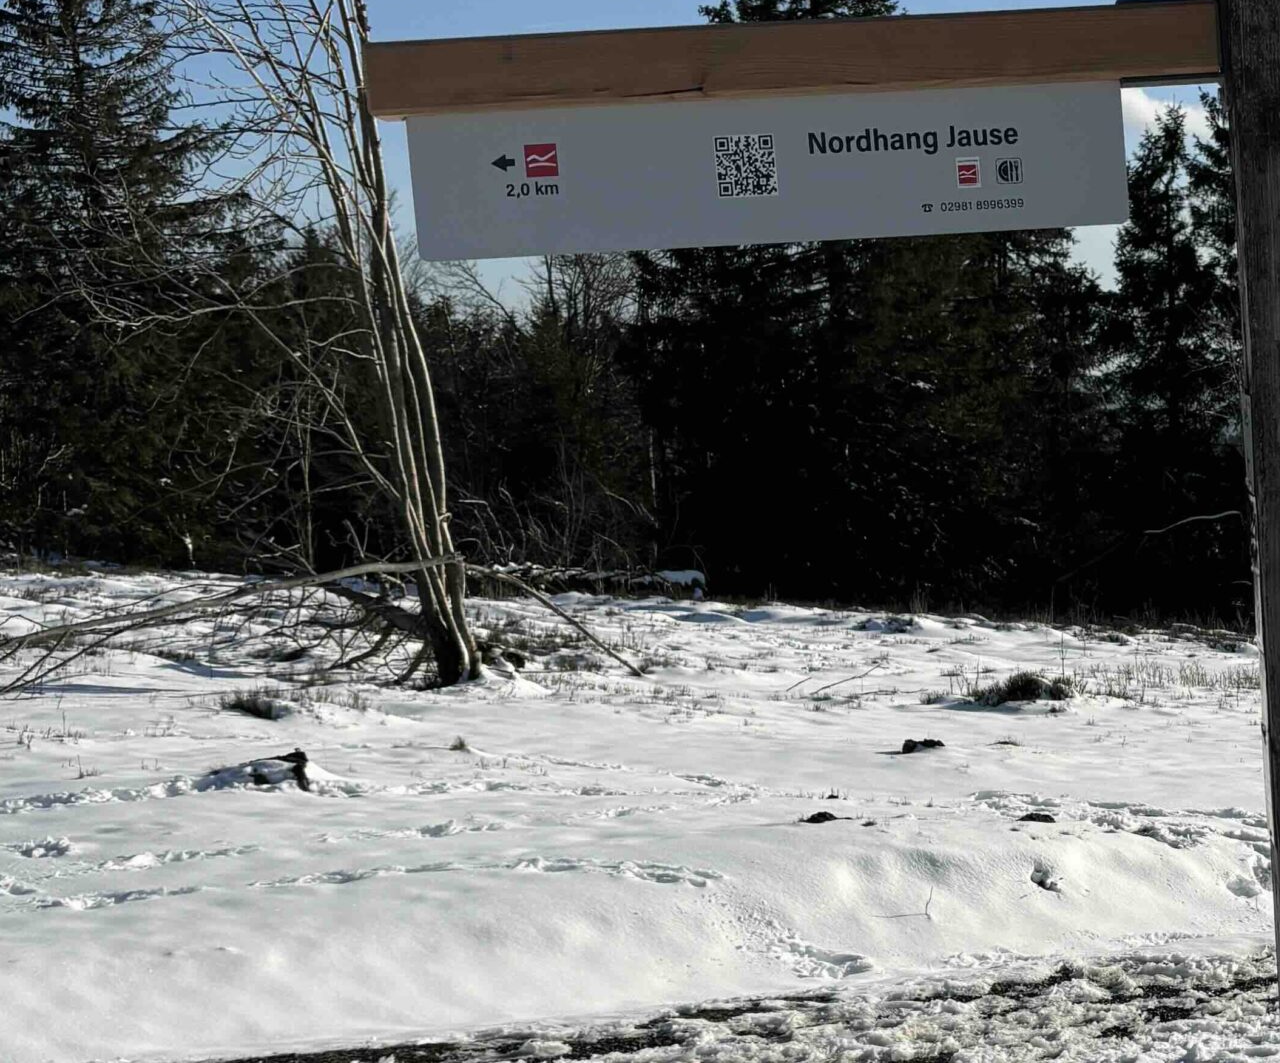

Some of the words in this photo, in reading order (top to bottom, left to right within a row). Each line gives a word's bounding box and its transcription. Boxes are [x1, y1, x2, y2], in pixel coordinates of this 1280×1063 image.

[808, 128, 938, 155] Nordhang
[946, 125, 1019, 148] Jause
[506, 183, 530, 199] 2,0
[535, 181, 559, 196] km
[940, 201, 973, 212] 02981
[976, 198, 1024, 210] 8996399
